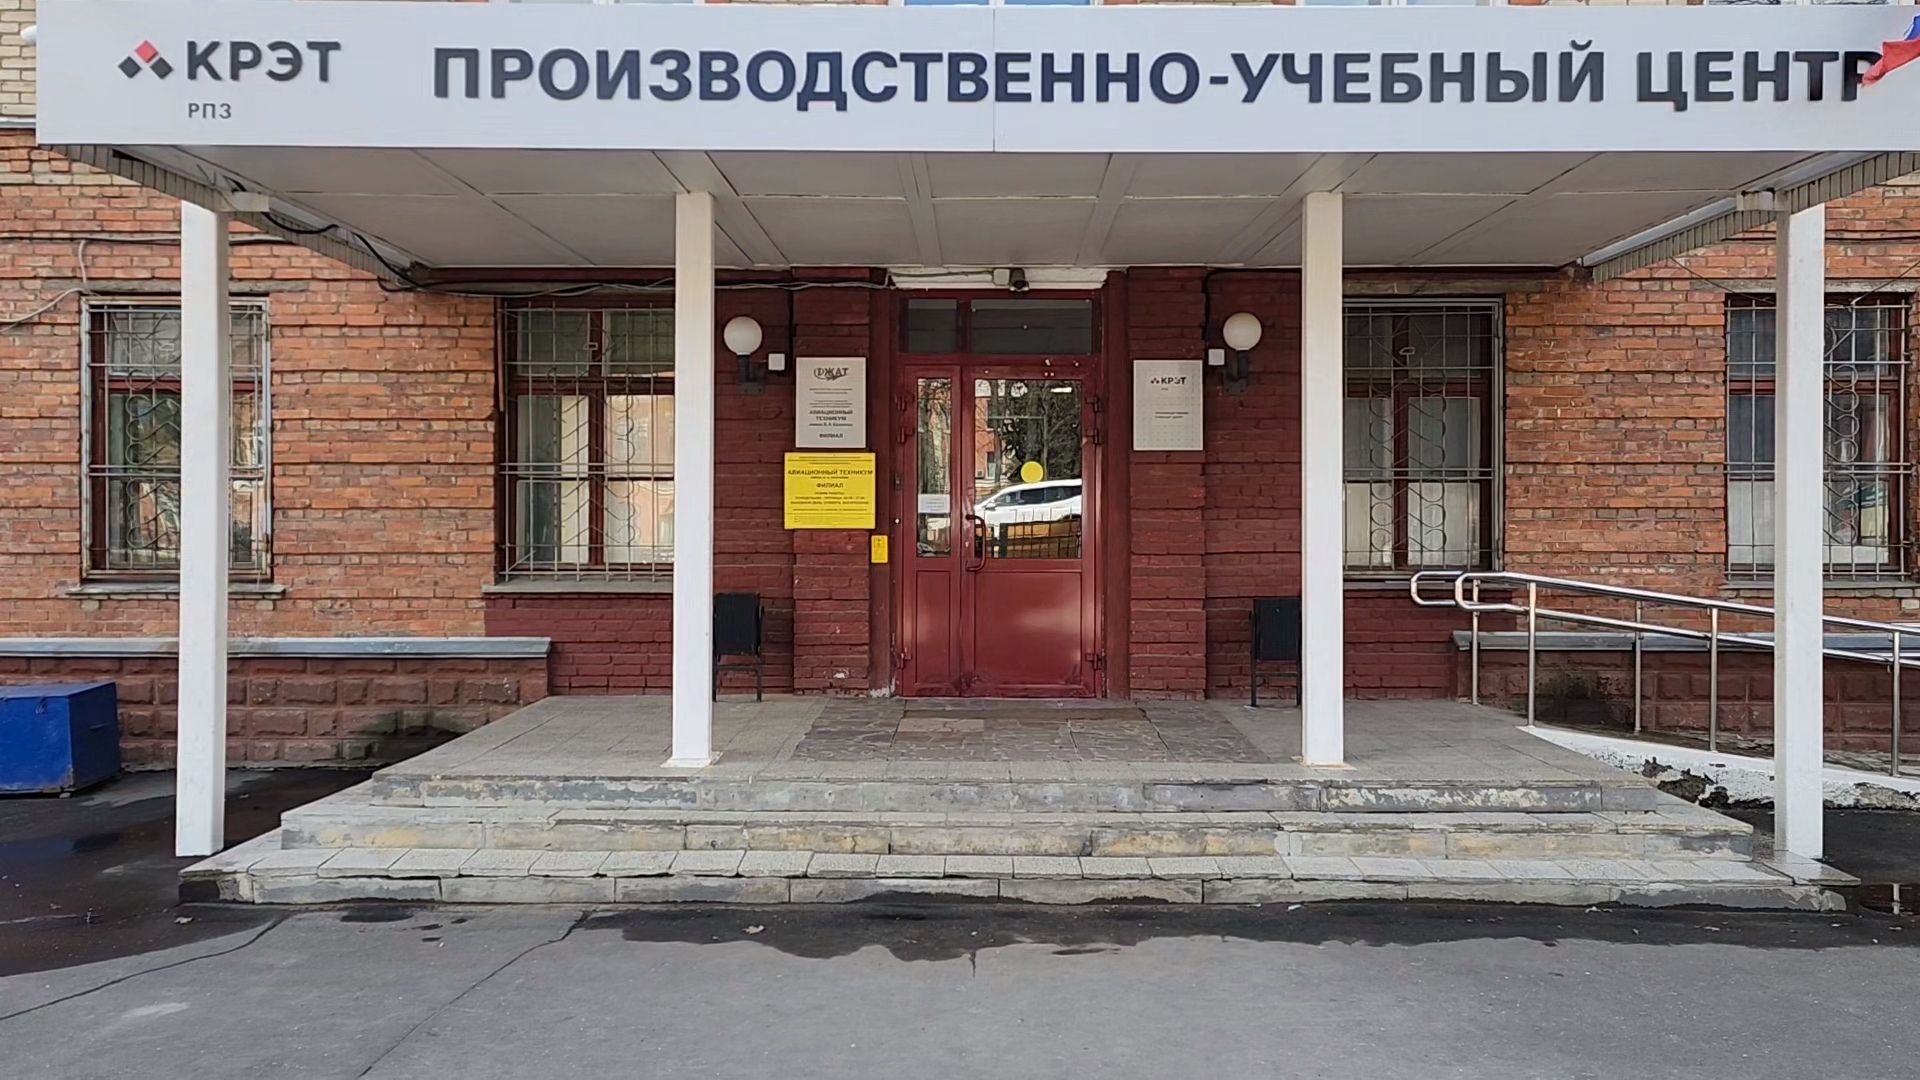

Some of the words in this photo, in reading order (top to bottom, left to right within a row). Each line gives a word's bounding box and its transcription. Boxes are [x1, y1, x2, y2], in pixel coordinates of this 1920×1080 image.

[187, 40, 342, 83] КРЭТ
[434, 39, 1605, 112] ПРОИЗВОДСТВЕННО-УЧЕБНЫЙ
[1636, 50, 1883, 113] ЦЕНТР
[188, 102, 232, 119] РПЗ
[1161, 376, 1187, 385] КРЭТ
